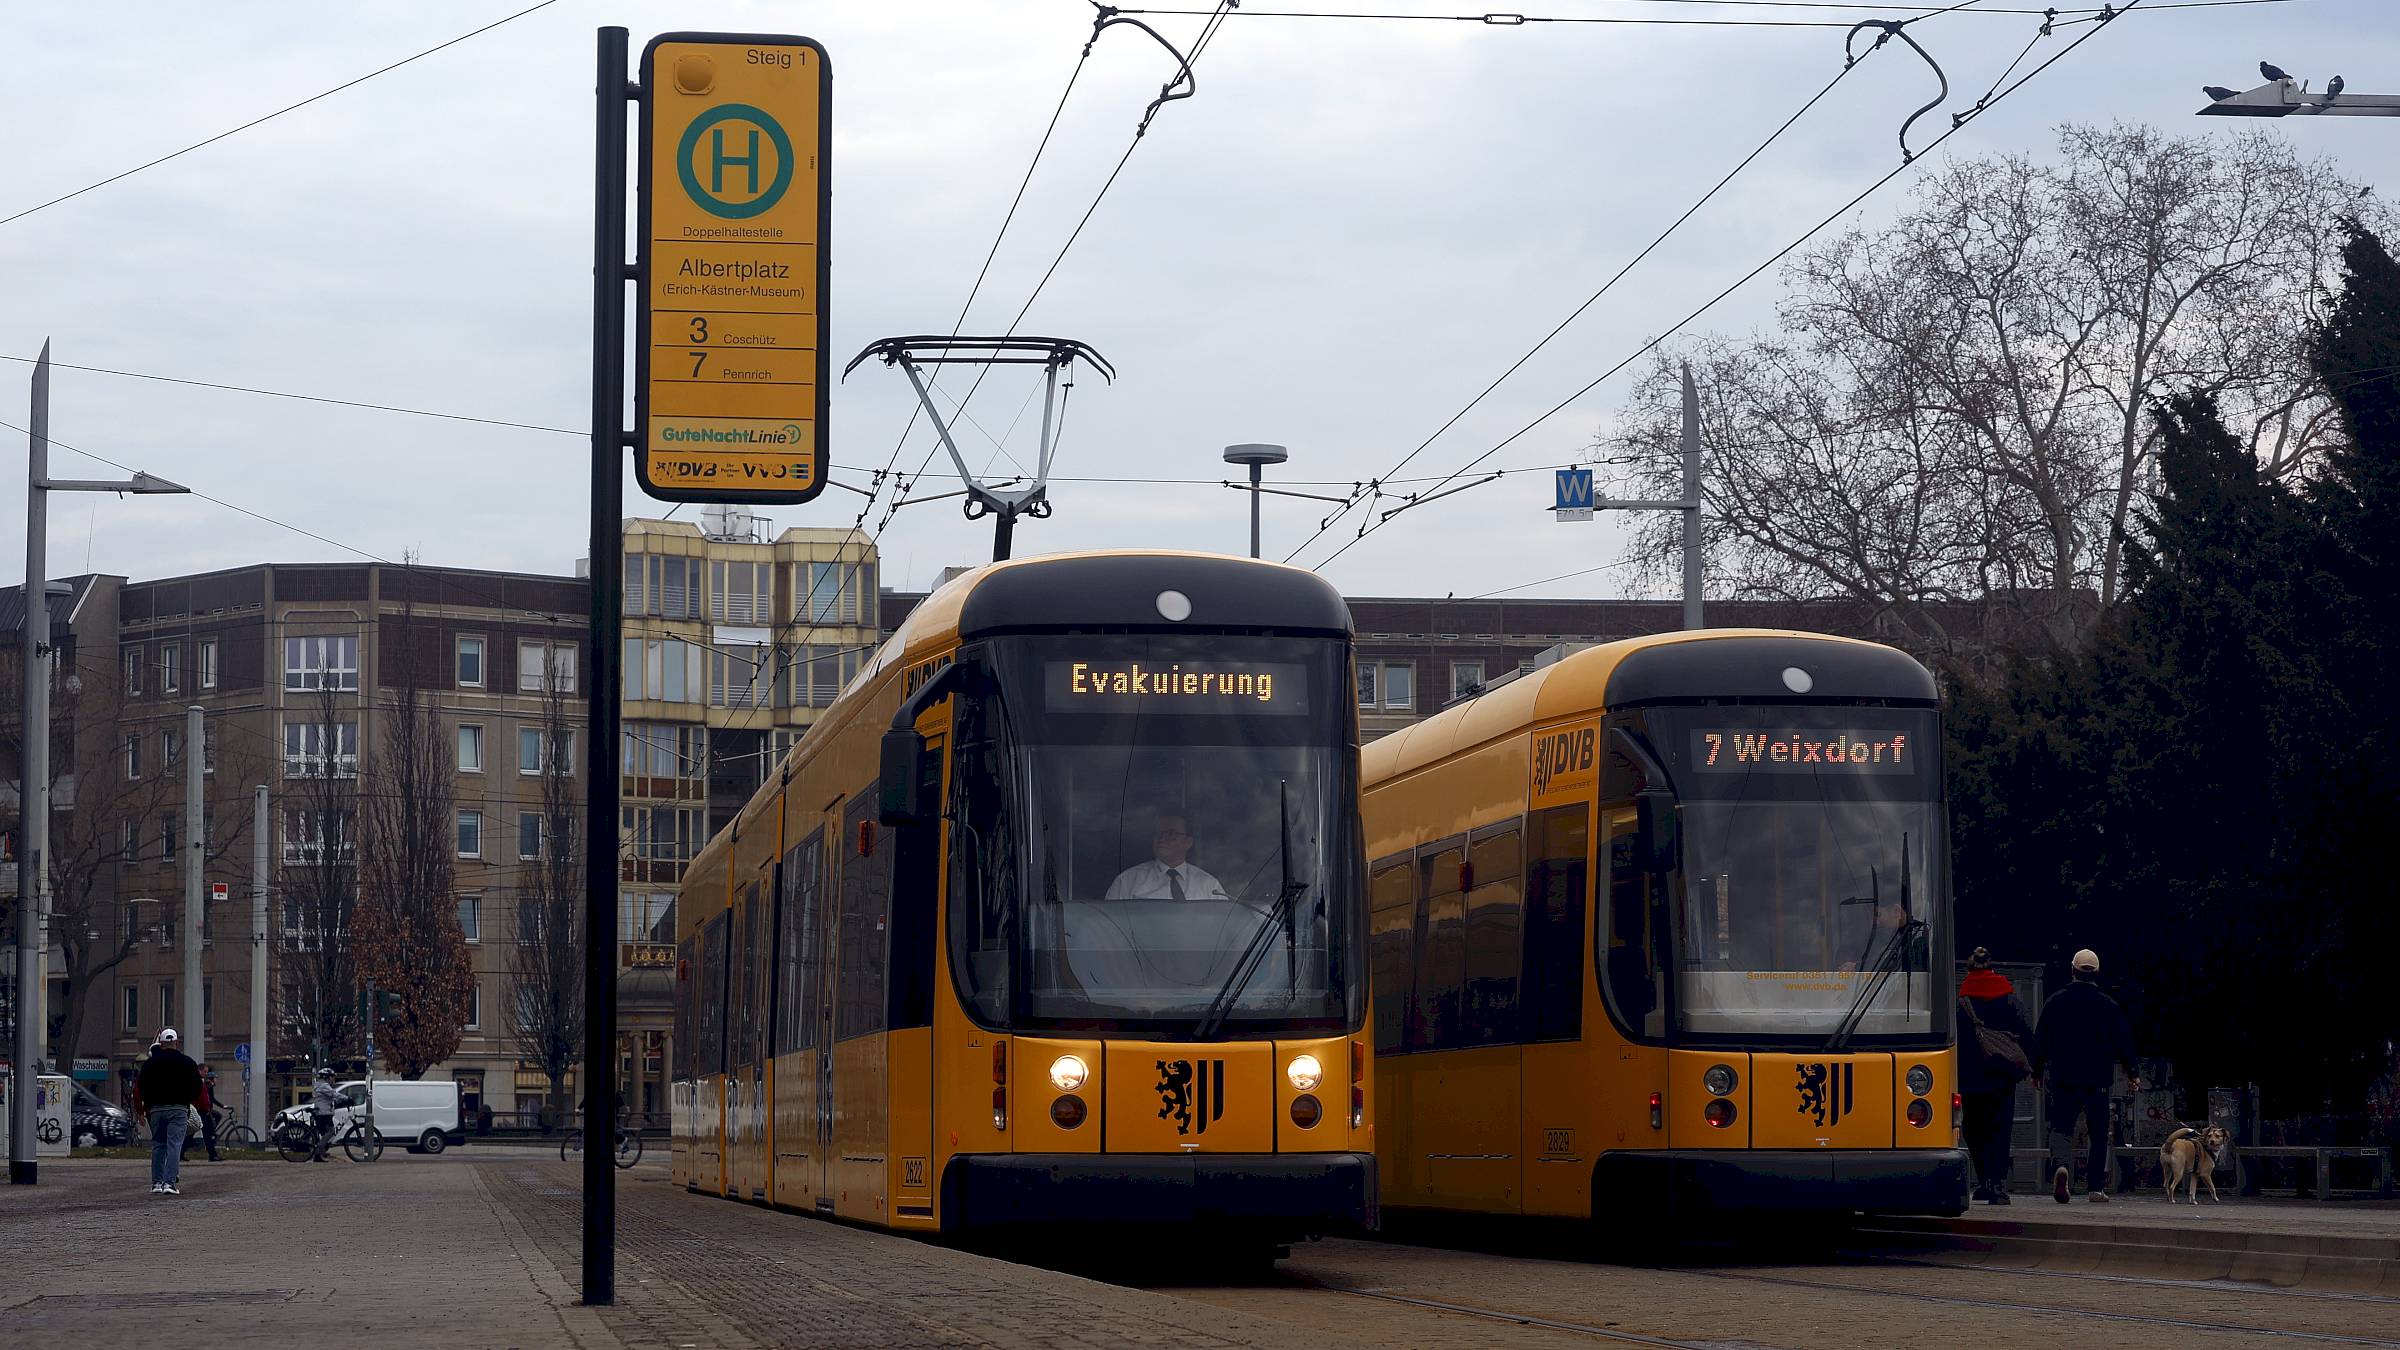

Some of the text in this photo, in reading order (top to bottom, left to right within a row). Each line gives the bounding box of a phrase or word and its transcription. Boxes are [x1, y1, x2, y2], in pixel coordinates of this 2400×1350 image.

[746, 49, 807, 69] Steig 1
[712, 128, 759, 194] H
[683, 226, 783, 240] Doppelhaltestelle
[678, 258, 790, 282] Albertplatz
[662, 283, 805, 302] (Erich-Kästner-Museum)
[689, 316, 776, 346] 3 Coschütz
[688, 351, 772, 381] 7 Pennrich
[662, 426, 788, 445] GuteNachtLinie
[677, 461, 718, 478] DVB
[1558, 474, 1591, 503] W
[1071, 662, 1273, 702] Evakuierung
[1554, 728, 1595, 775] DVB
[1704, 732, 1906, 766] 7 Weixdorf
[73, 1060, 108, 1070] Waschsalon
[1548, 1132, 1569, 1152] 2829
[905, 1160, 923, 1184] 2622
